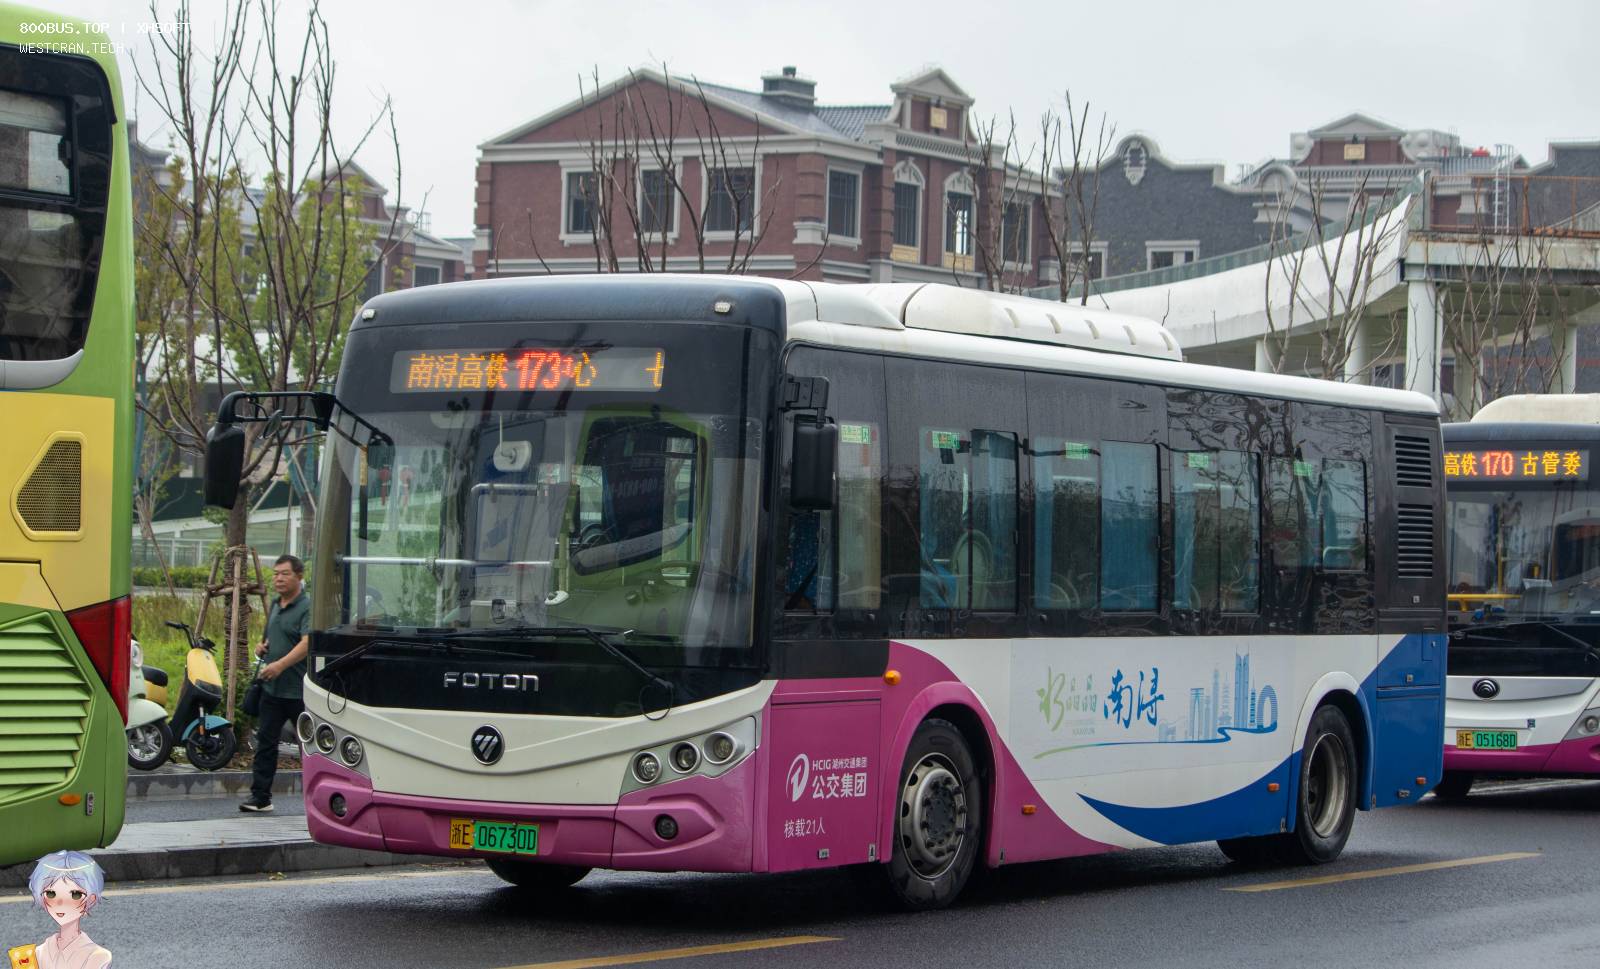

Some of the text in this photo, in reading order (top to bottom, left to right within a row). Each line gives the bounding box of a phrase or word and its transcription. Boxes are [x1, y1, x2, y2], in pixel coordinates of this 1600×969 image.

[408, 352, 509, 389] 南浔高铁
[516, 351, 561, 389] 173
[1444, 451, 1582, 476] 高铁 170 古管委
[443, 671, 539, 692] FOTON
[1476, 733, 1516, 748] 05168D
[812, 760, 832, 772] HCIG
[812, 772, 867, 799] 公交集团
[478, 825, 537, 850] 06730D
[784, 817, 826, 840] 核载21人
